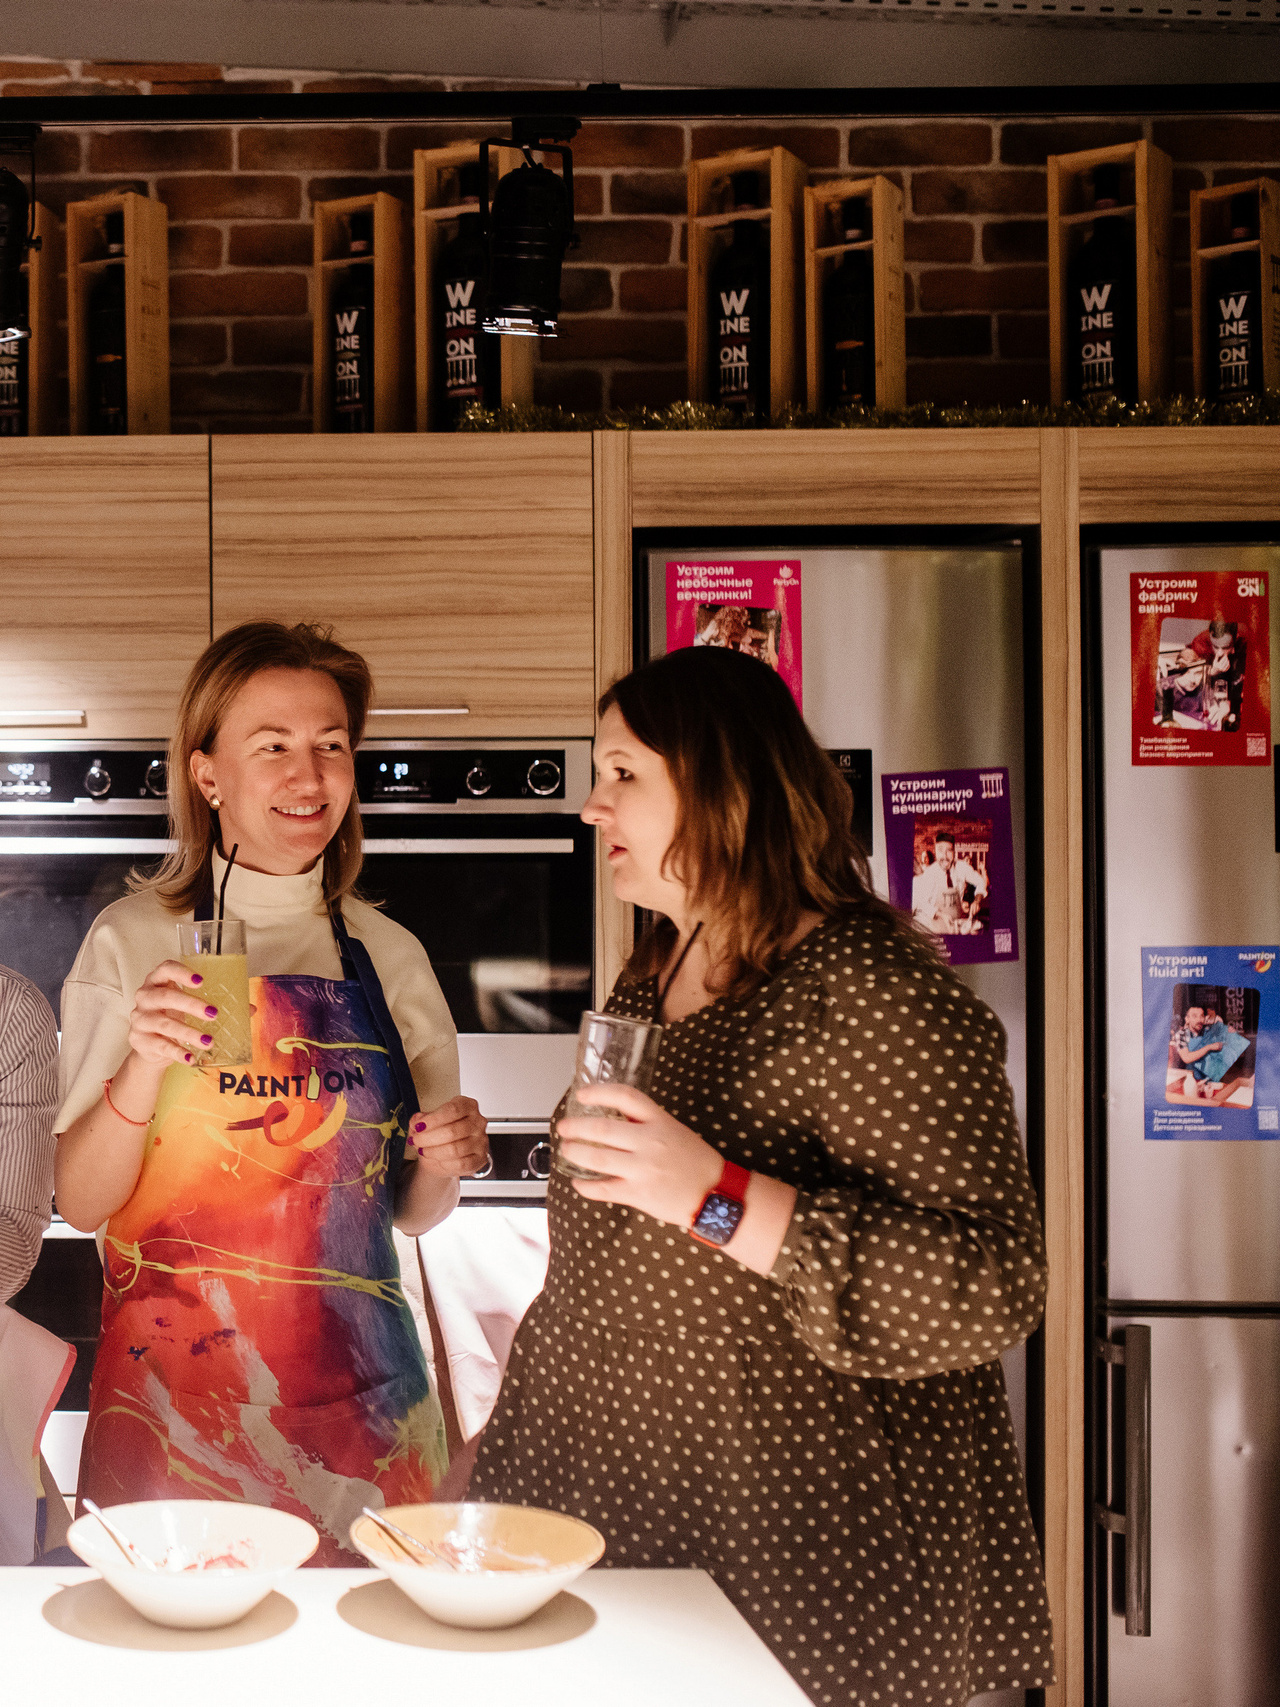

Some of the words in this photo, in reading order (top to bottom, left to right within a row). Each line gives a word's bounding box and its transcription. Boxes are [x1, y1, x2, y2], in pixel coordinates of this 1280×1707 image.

[445, 280, 475, 308] W
[720, 288, 750, 316] W
[1081, 284, 1112, 312] W
[1219, 295, 1248, 320] W
[335, 310, 359, 334] W
[445, 308, 477, 328] INE
[720, 316, 750, 335] INE
[1081, 311, 1114, 332] INE
[1219, 320, 1249, 337] INE
[336, 335, 360, 352] INE
[446, 337, 475, 357] ON
[1081, 340, 1111, 359] ON
[720, 344, 748, 363] ON
[1219, 346, 1246, 362] ON
[335, 360, 358, 376] ON
[676, 564, 734, 578] Устроим
[676, 577, 753, 589] необычные
[1138, 577, 1198, 592] Устроим
[1237, 577, 1260, 585] WINE
[676, 588, 752, 602] вечеринки!
[1138, 590, 1198, 604] фабрику
[1237, 585, 1260, 598] ON
[1138, 602, 1175, 614] вина!
[890, 779, 946, 792] Устроим
[891, 788, 974, 804] кулинарную
[892, 799, 967, 815] вечеринку!
[1148, 954, 1208, 967] Устроим
[1149, 966, 1178, 978] fluid
[1180, 966, 1205, 978] art!
